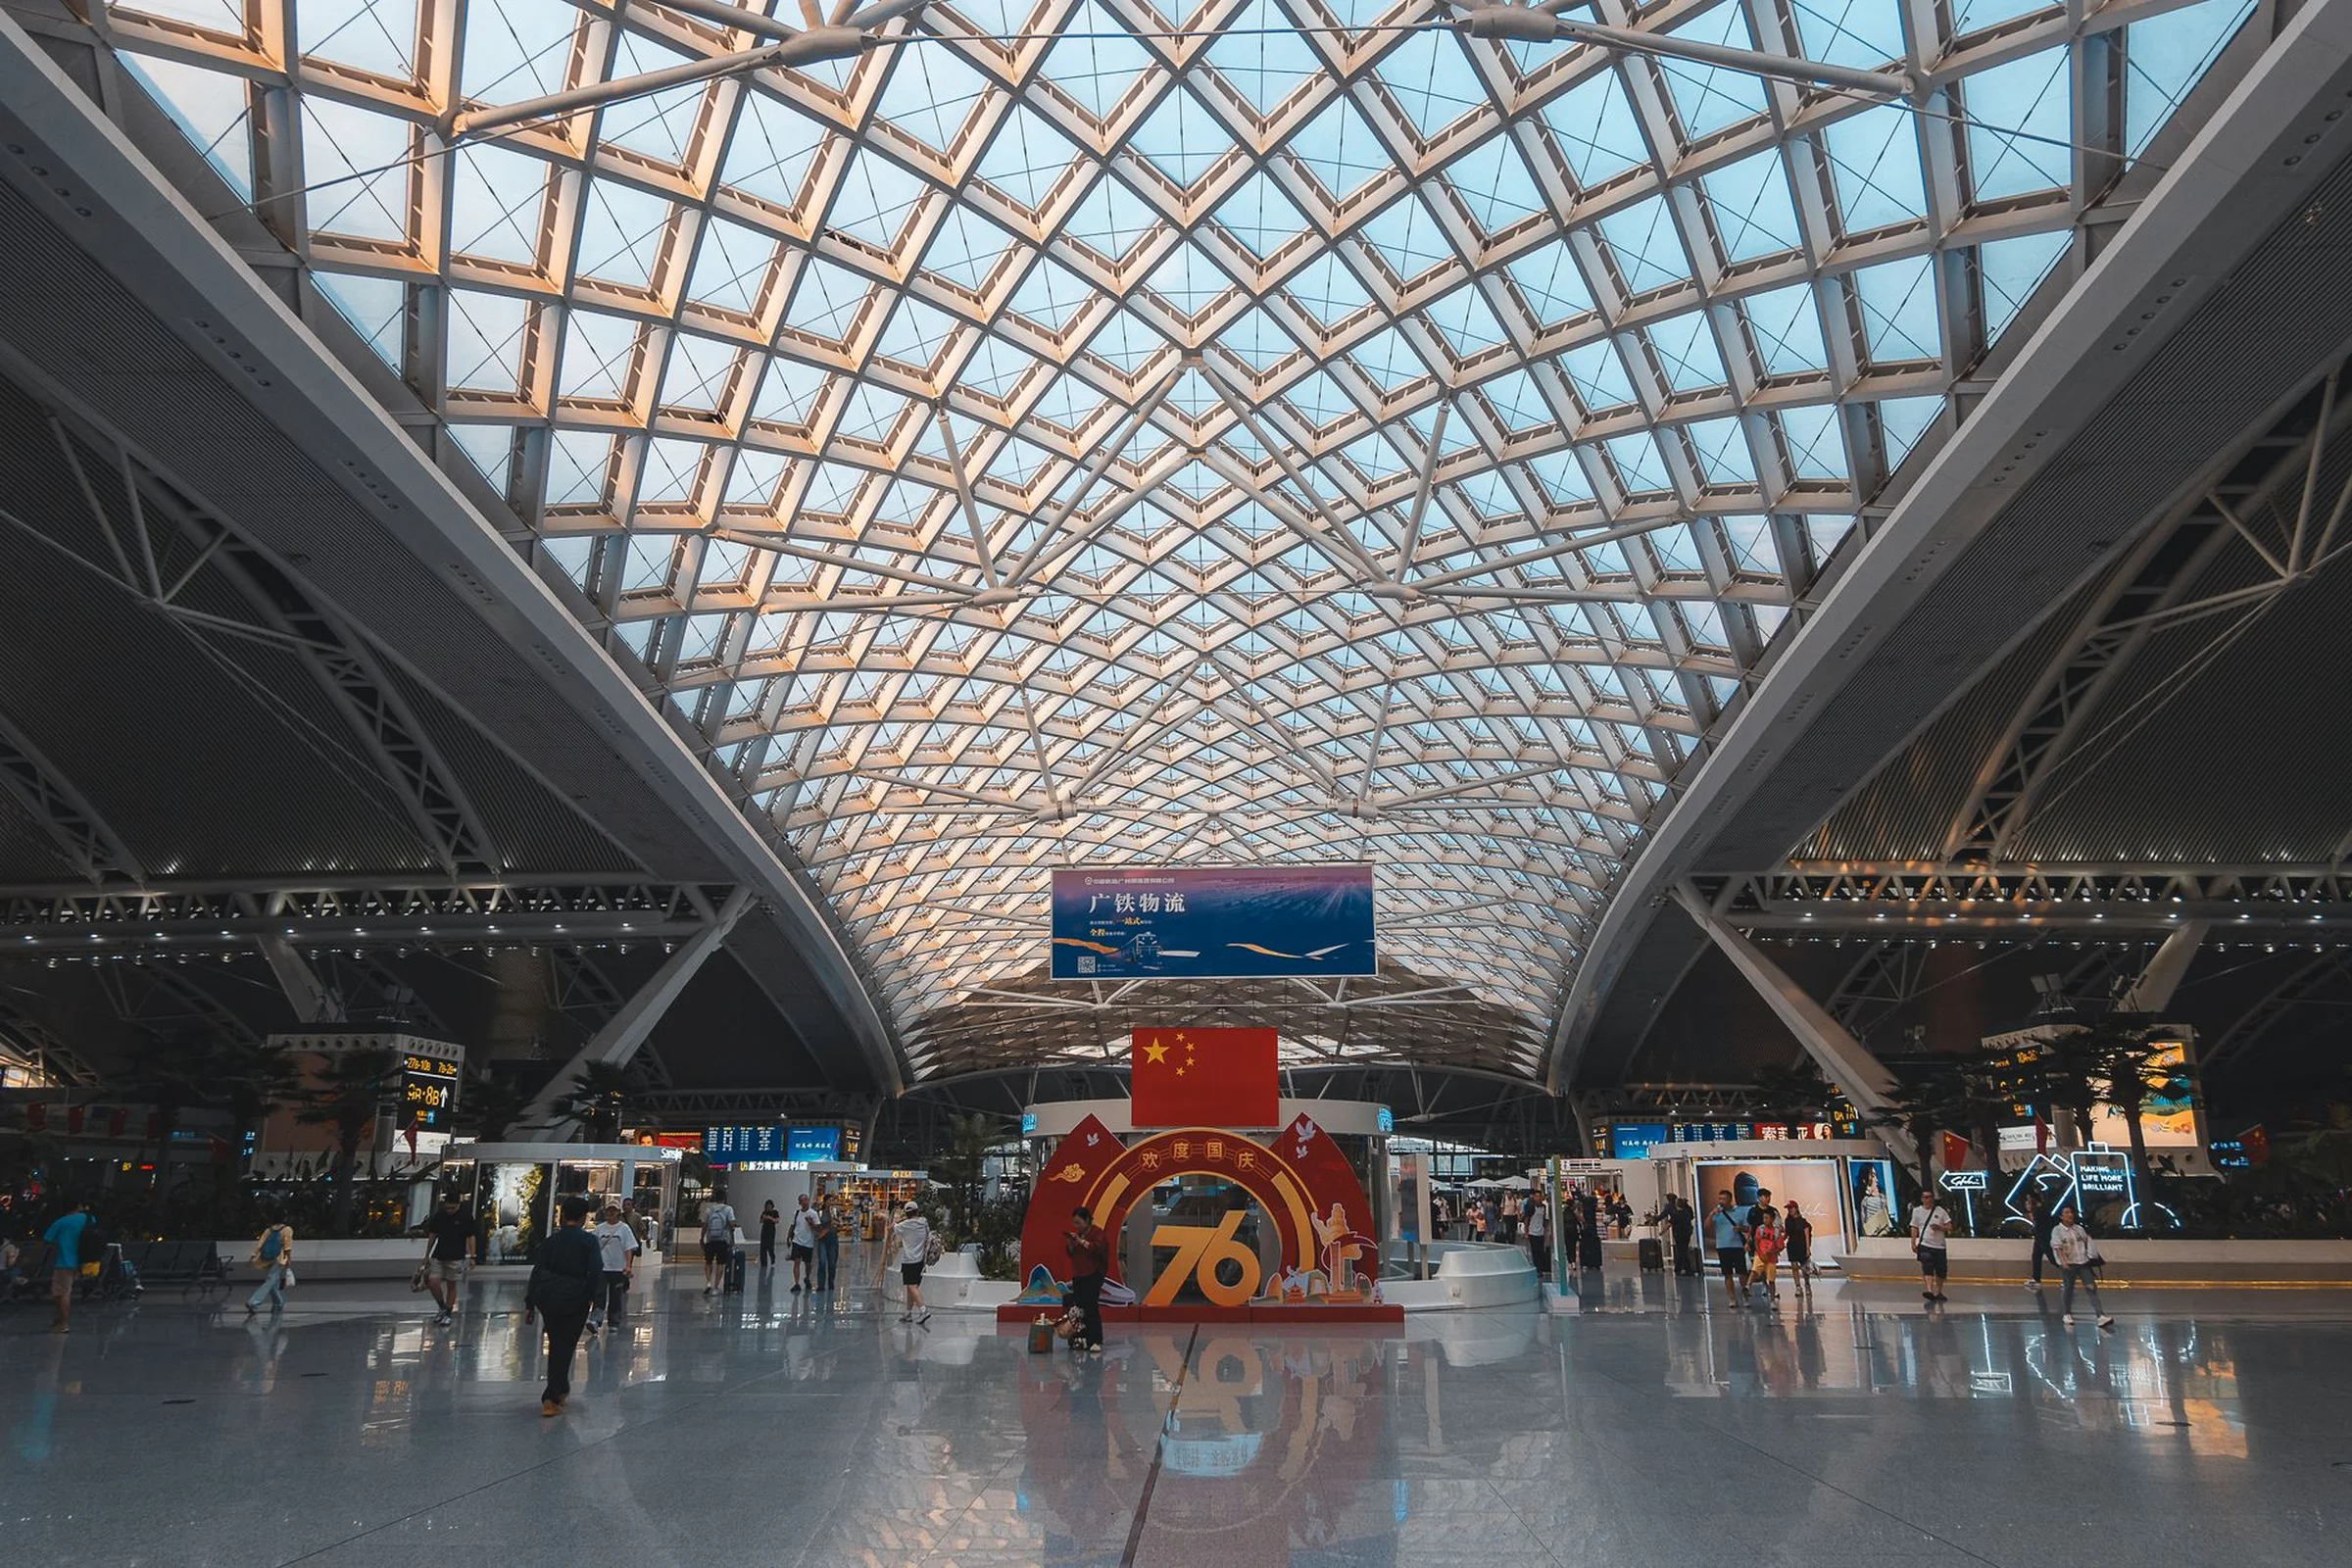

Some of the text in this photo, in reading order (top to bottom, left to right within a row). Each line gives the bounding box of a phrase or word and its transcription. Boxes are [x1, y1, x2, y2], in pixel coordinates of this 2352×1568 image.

[1089, 892, 1186, 913] 广铁物流
[1142, 1142, 1255, 1168] 欢度国庆
[1142, 1209, 1261, 1306] 76
